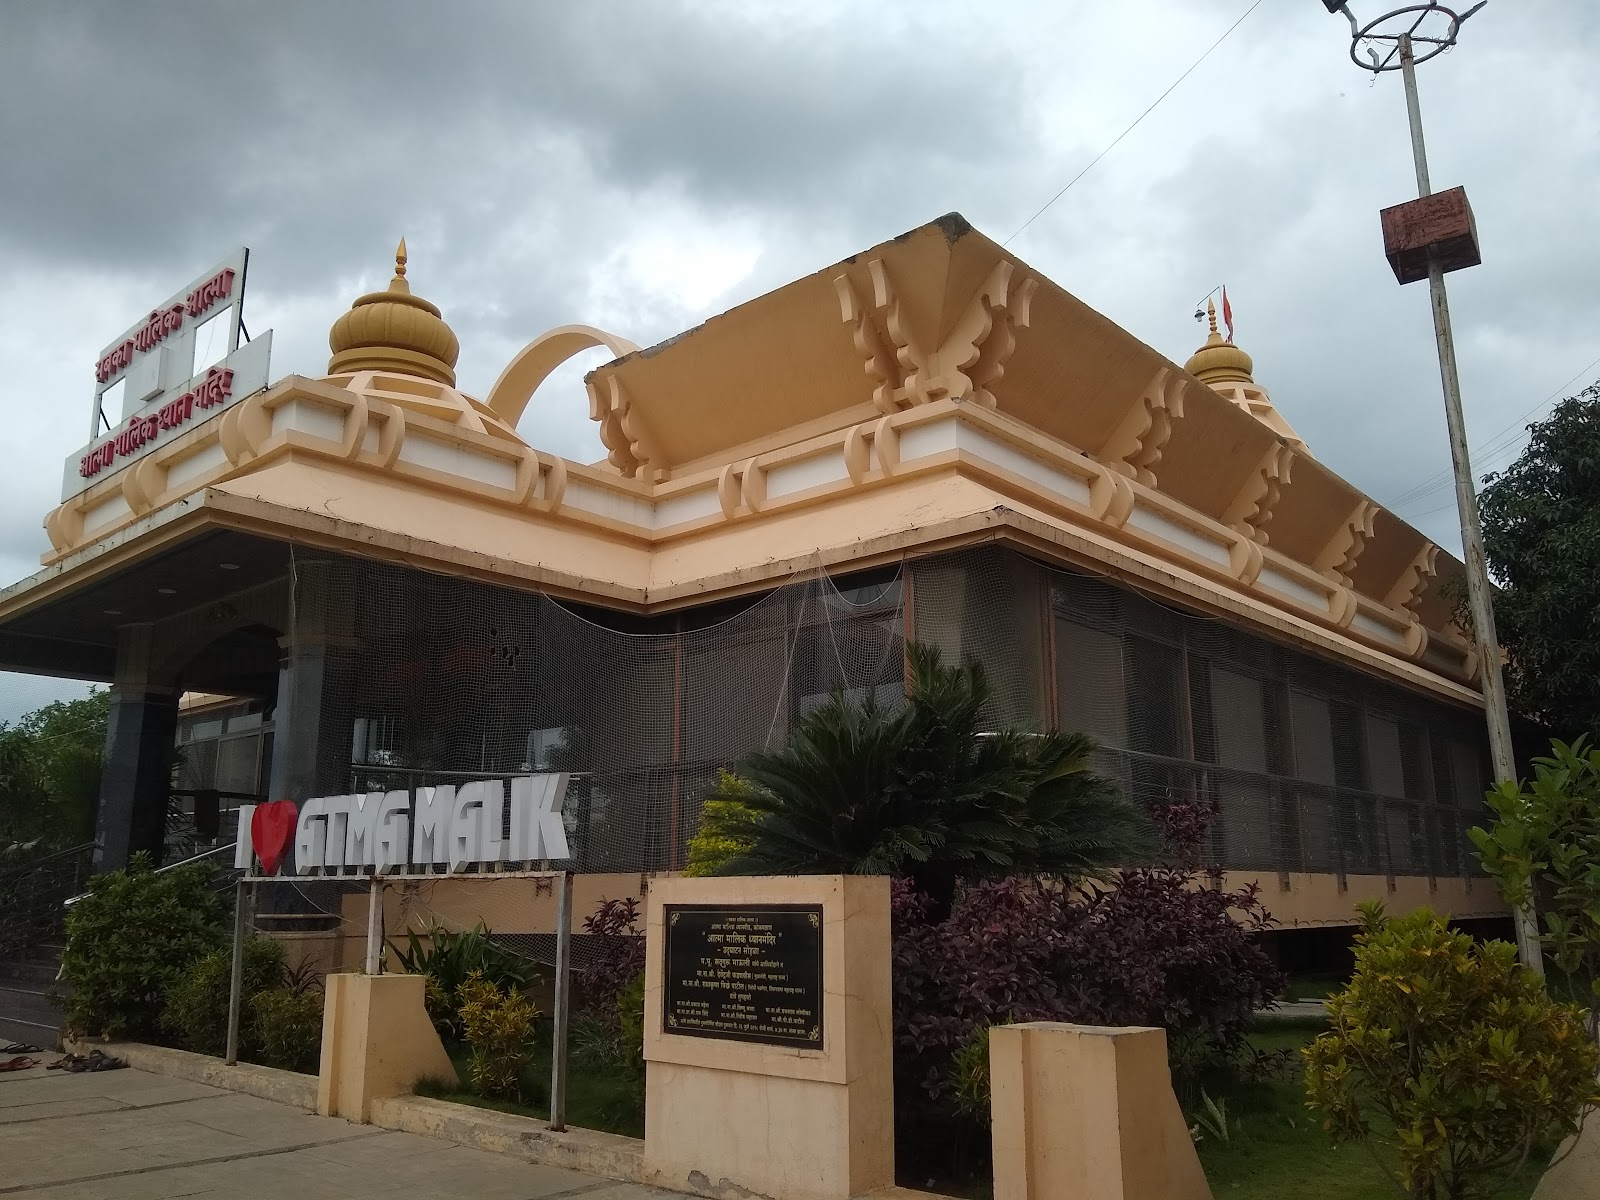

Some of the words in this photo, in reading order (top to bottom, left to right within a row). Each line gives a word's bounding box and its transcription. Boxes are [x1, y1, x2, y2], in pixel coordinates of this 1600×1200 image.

[95, 339, 133, 383] सबका
[133, 303, 184, 353] मालिक
[185, 267, 235, 318] आत्मा
[79, 440, 115, 478] आत्मा
[114, 414, 158, 456] मालिक
[158, 392, 194, 430] ध्यान
[234, 805, 256, 868] I
[707, 934, 724, 943] आत्मा
[726, 932, 746, 944] मालिक
